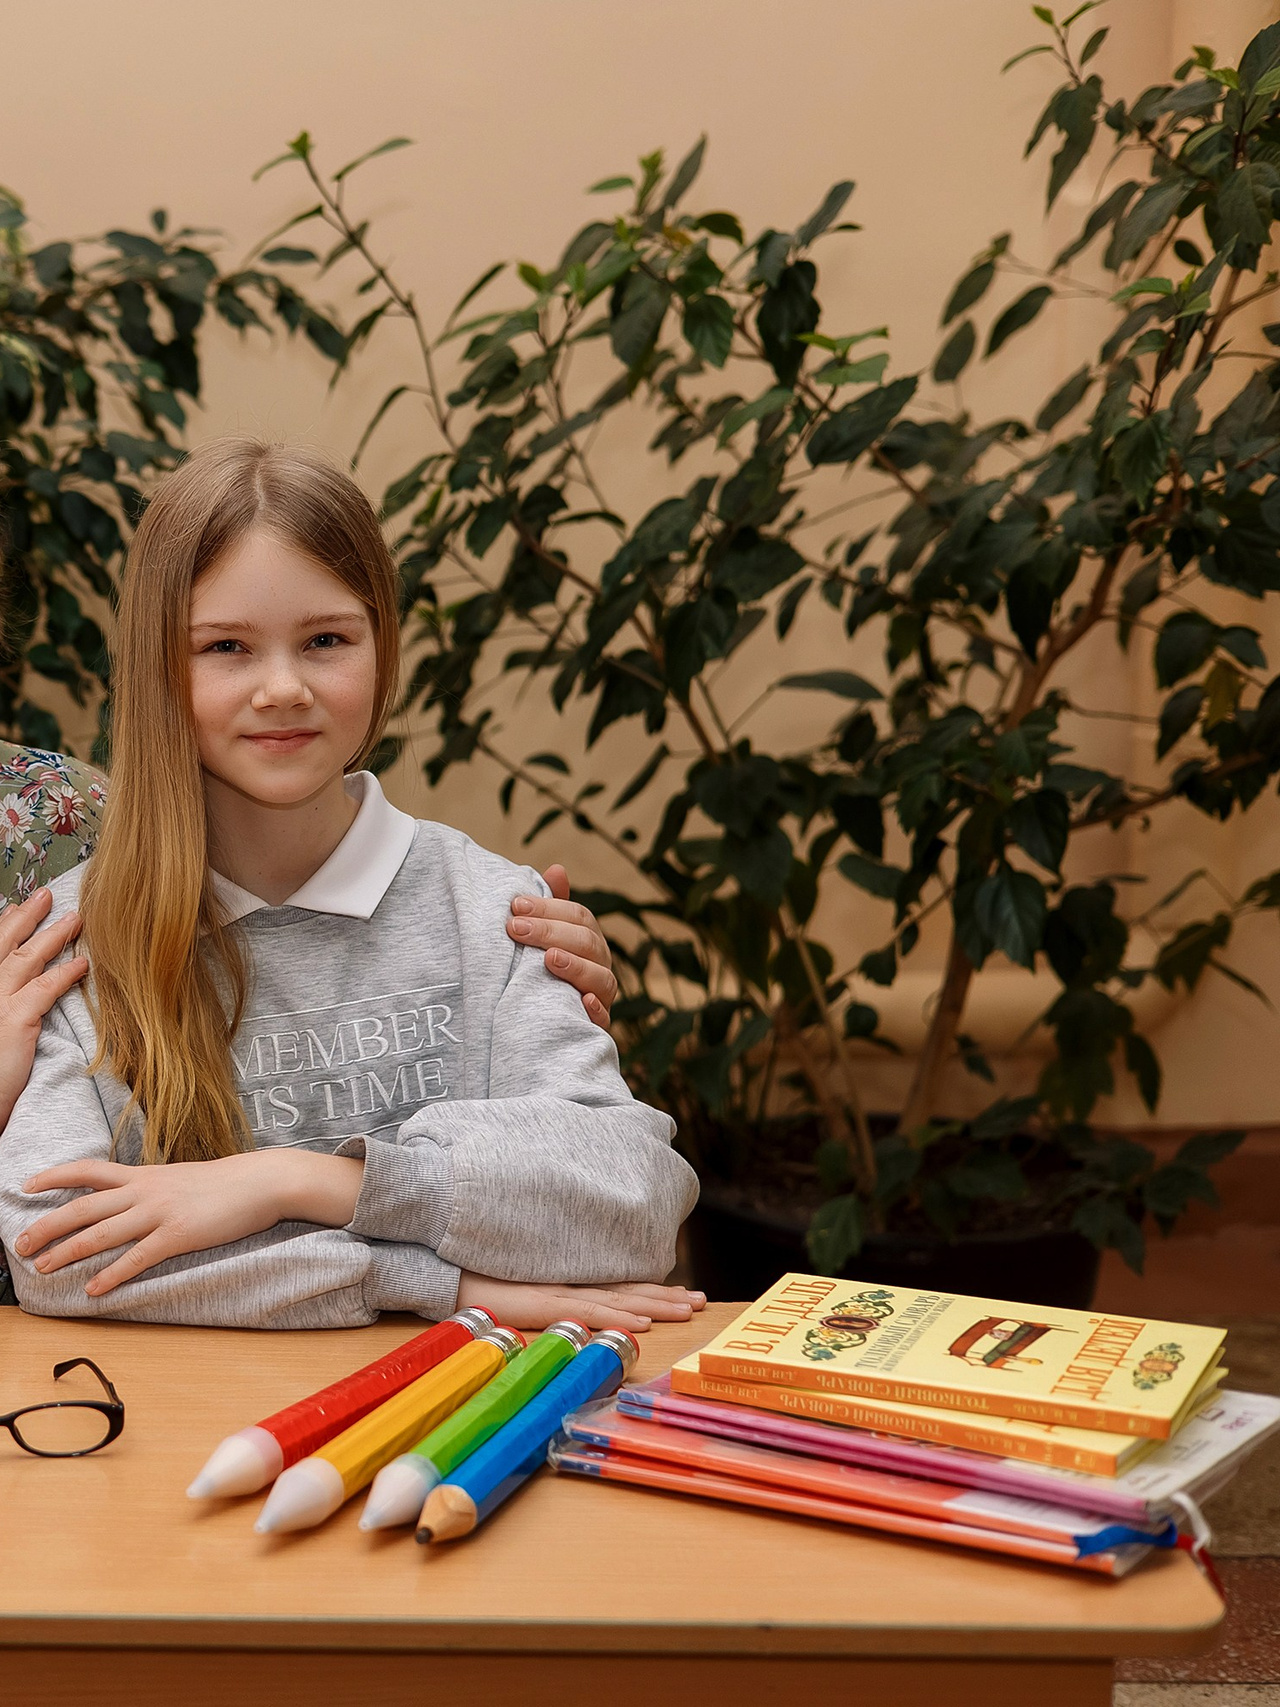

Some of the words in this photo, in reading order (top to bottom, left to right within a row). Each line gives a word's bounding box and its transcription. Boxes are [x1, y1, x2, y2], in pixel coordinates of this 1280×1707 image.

[229, 1004, 463, 1080] MEMBER
[238, 1084, 300, 1132] IS
[310, 1058, 449, 1121] TIME
[760, 1281, 837, 1320] ДАЛЬ
[741, 1321, 798, 1337] И.
[855, 1325, 911, 1368] ТОЛКОВЫЙ
[894, 1295, 940, 1325] СЛОВАРЬ
[723, 1340, 780, 1354] В.
[1075, 1318, 1146, 1368] ДЕТЕЙ
[731, 1364, 770, 1377] ДЕТЕЙ
[772, 1369, 796, 1381] ДЛЯ
[700, 1380, 736, 1395] ДЕТЕЙ
[737, 1387, 762, 1399] ДЛЯ
[816, 1374, 890, 1397] СЛОВАРЬ
[1050, 1364, 1114, 1402] ДЛЯ
[780, 1394, 849, 1417] СЛОВАРЬ
[894, 1385, 990, 1410] ТОЛКОВЫЙ
[853, 1407, 942, 1436] ТОЛКОВЫЙ
